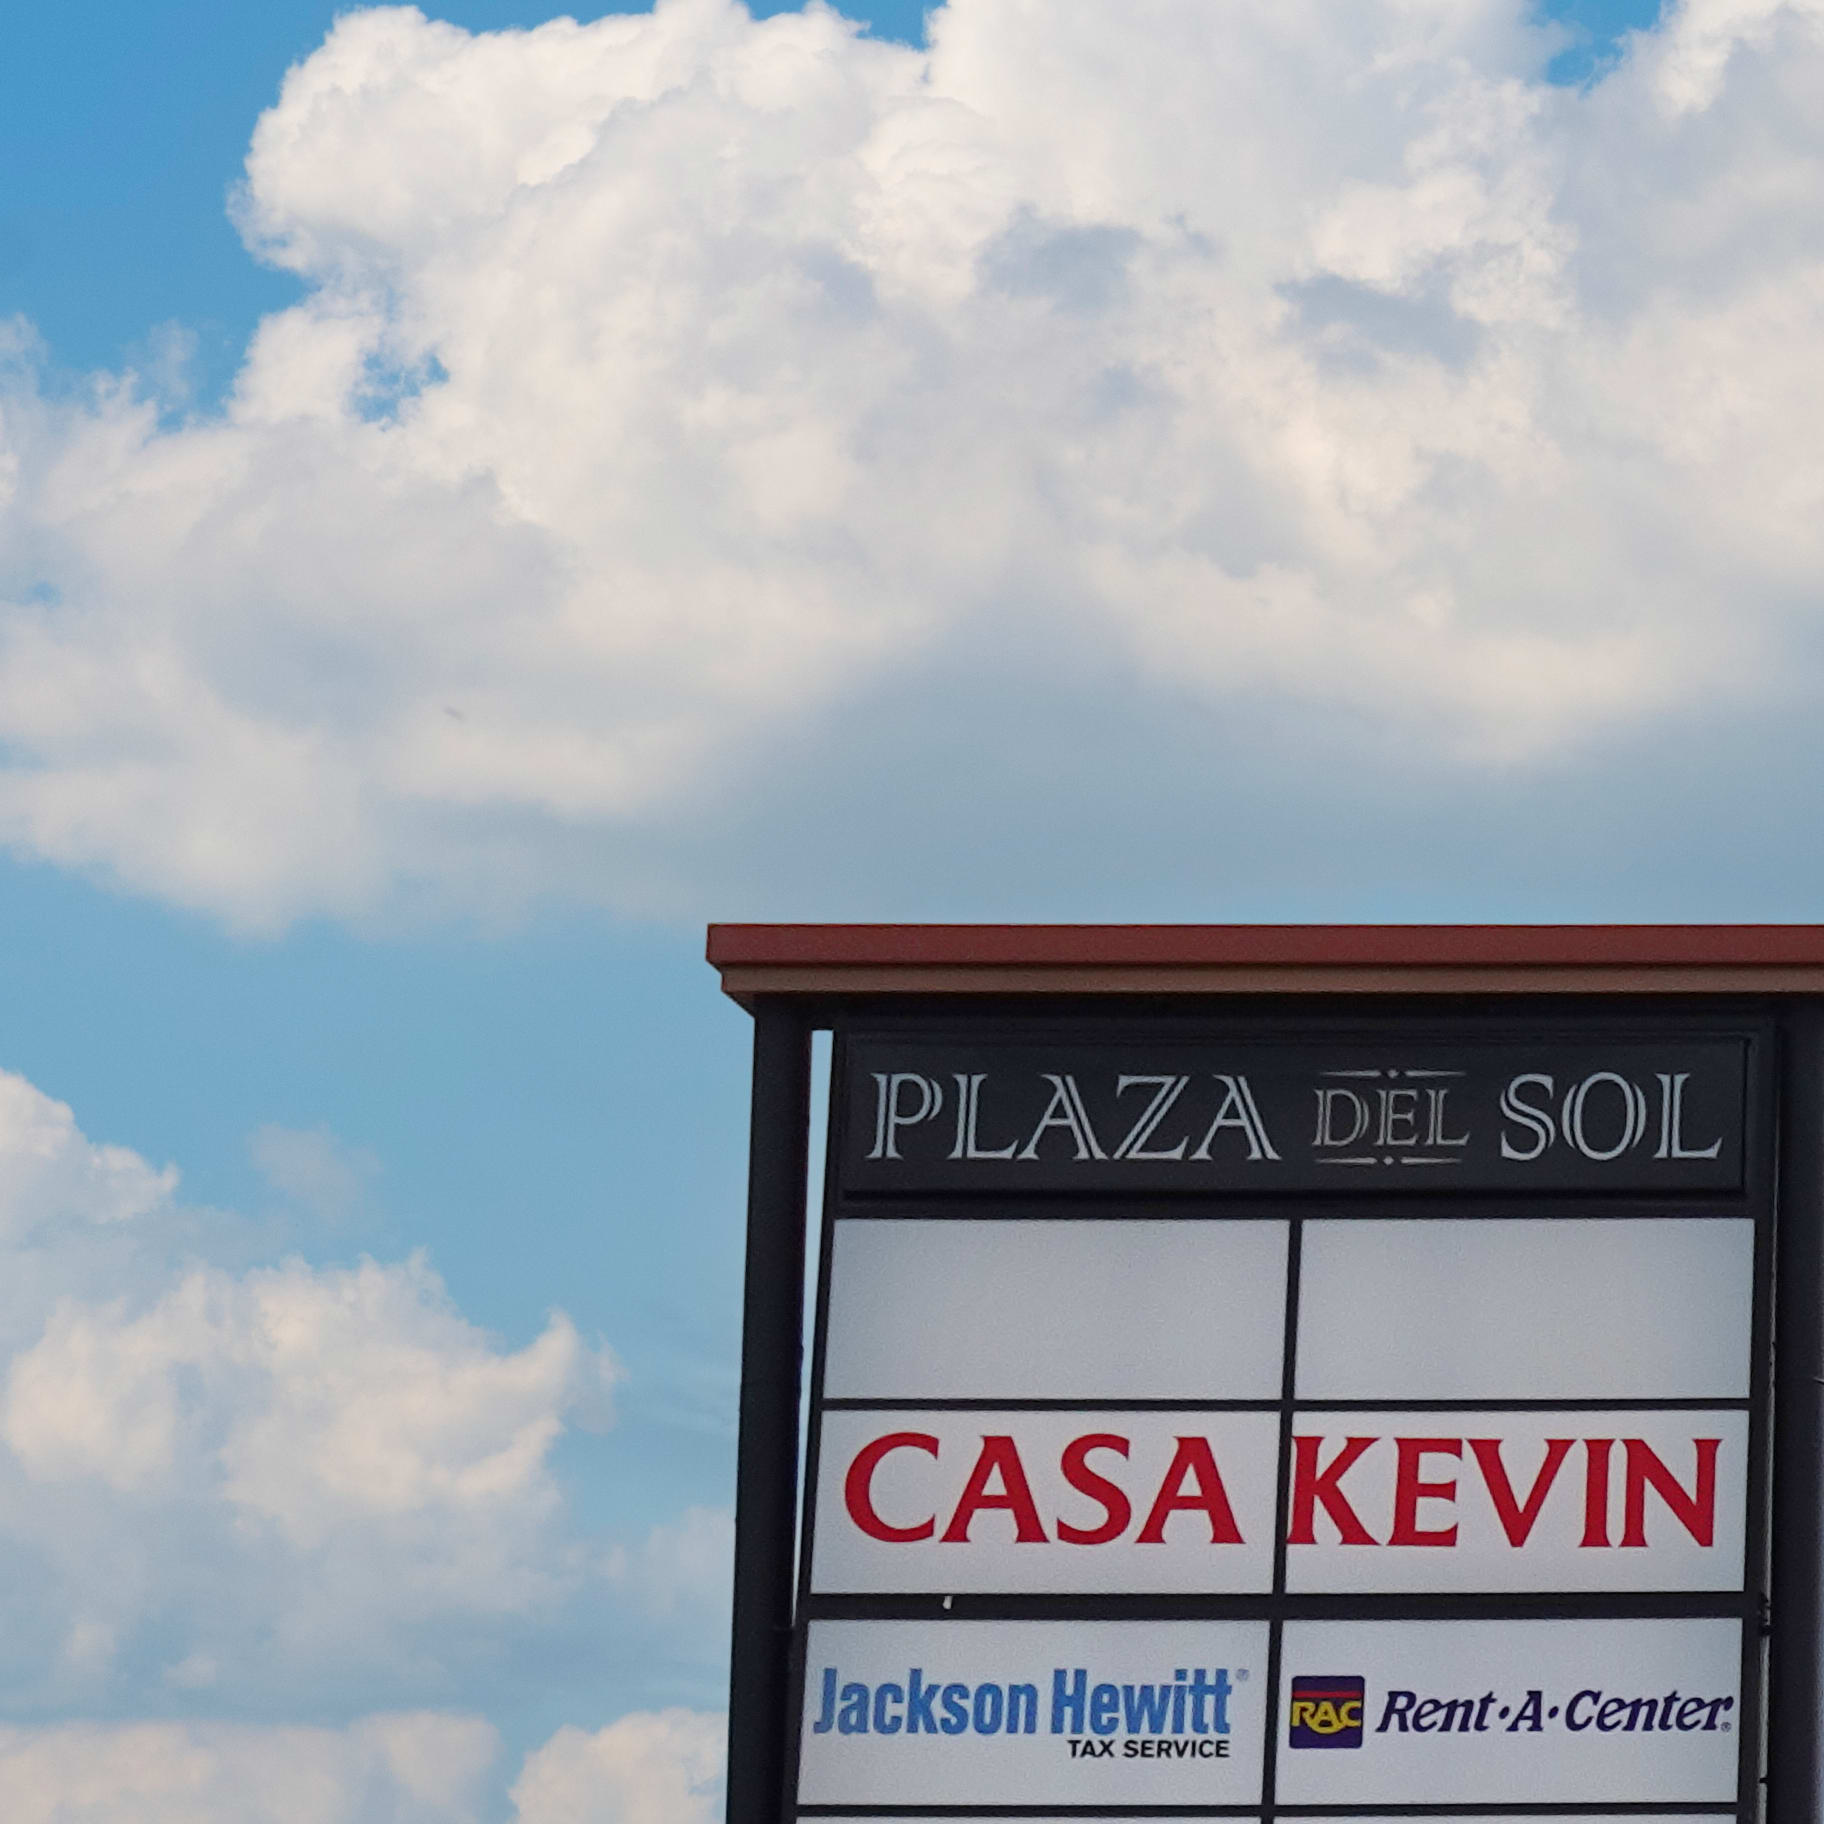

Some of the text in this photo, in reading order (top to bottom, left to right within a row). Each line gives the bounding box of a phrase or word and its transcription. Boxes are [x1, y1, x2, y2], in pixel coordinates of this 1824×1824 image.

[867, 1072, 1722, 1161] PLAZA DEL SOL
[845, 1432, 1719, 1548] CASA KEVIN
[813, 1668, 1233, 1735] Jackson Hewitt
[1291, 1700, 1362, 1735] RAC
[1067, 1739, 1231, 1759] TAX SERVICE
